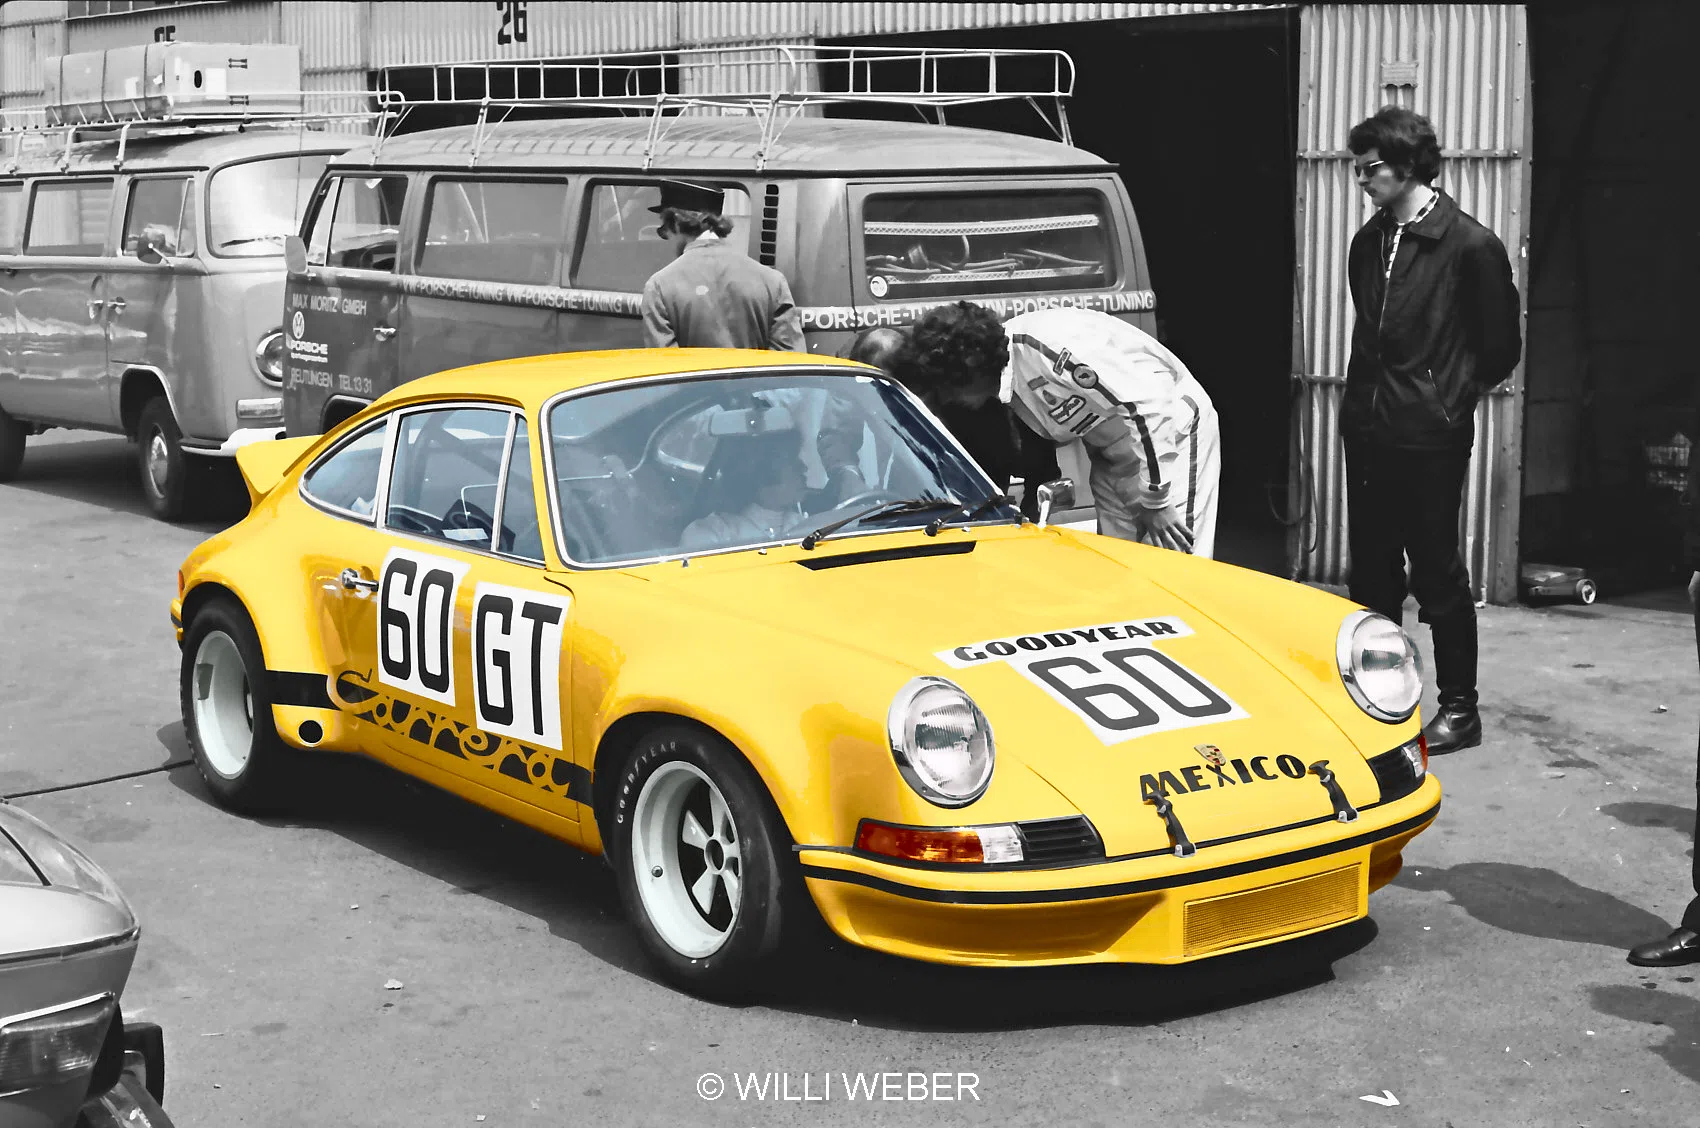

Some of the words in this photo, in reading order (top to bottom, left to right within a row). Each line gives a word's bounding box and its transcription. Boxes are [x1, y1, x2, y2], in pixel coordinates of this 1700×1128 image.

[496, 0, 528, 46] 26
[292, 293, 308, 309] MAX
[310, 295, 339, 313] MORITZ
[381, 558, 454, 694] 60
[476, 594, 563, 736] GT
[953, 621, 1179, 662] GOODYEAR
[1028, 648, 1232, 731] 60
[327, 669, 570, 797] Carrera
[617, 741, 677, 824] GOODYEAR
[1139, 754, 1306, 802] MEXICO
